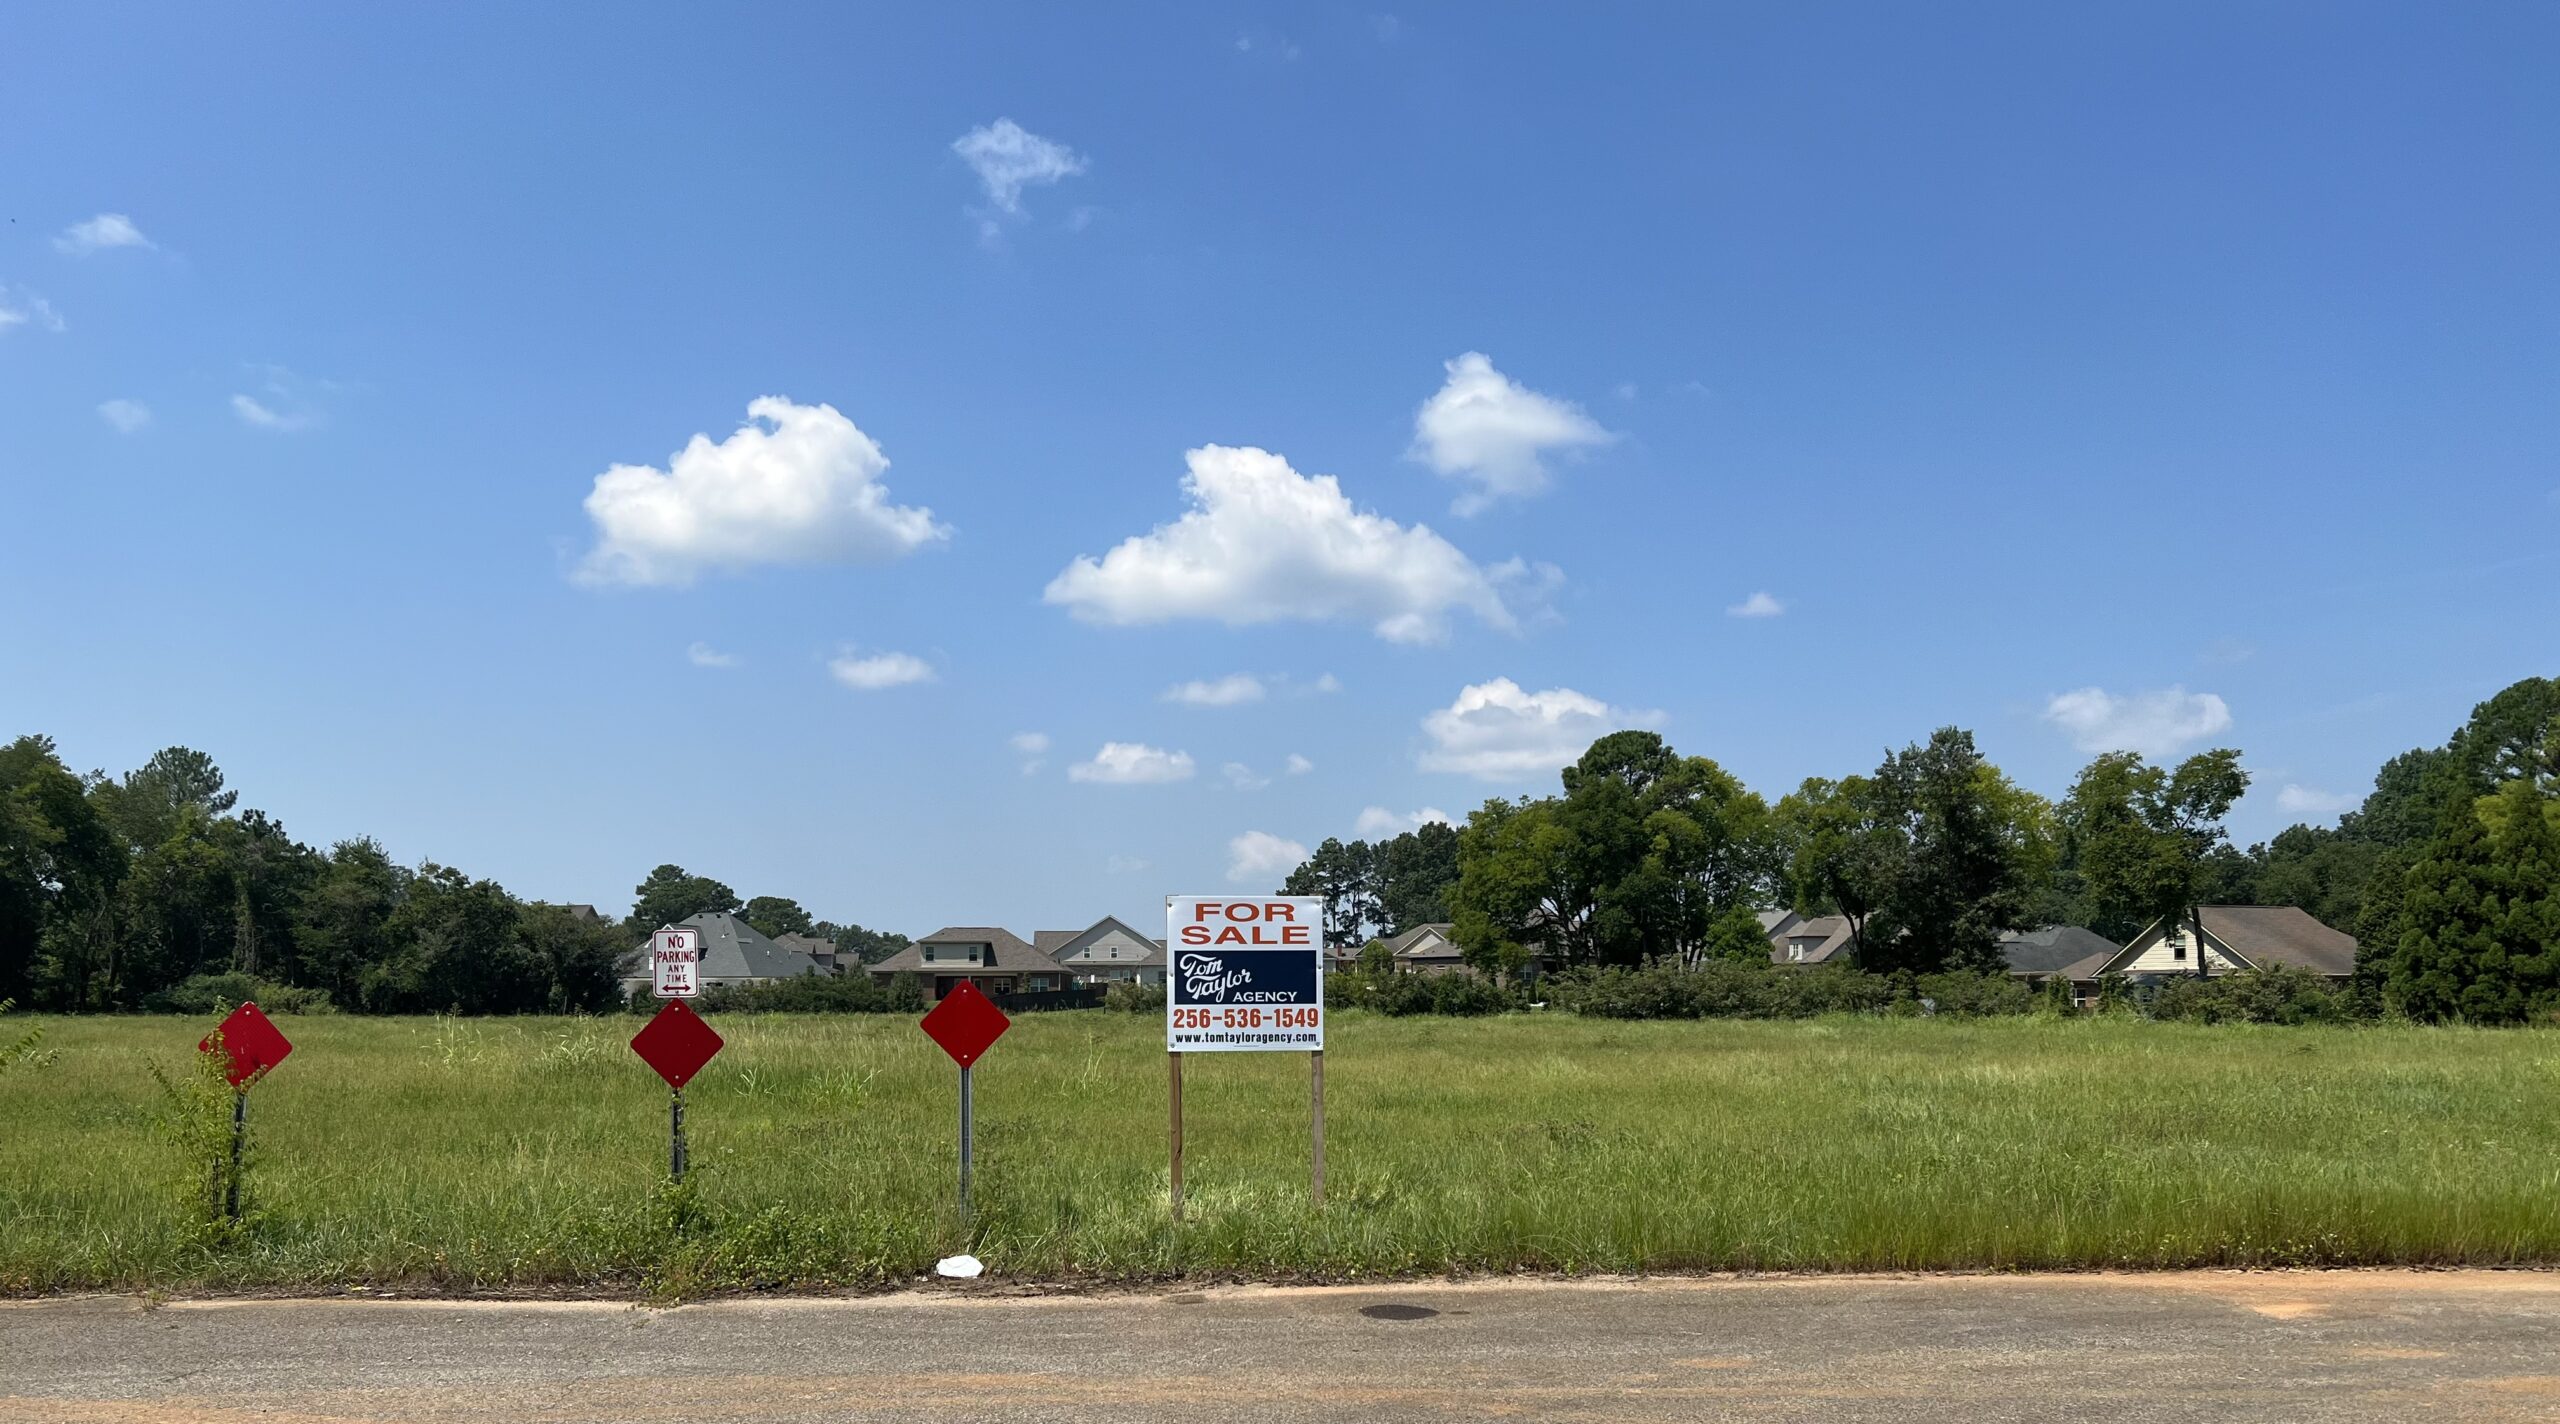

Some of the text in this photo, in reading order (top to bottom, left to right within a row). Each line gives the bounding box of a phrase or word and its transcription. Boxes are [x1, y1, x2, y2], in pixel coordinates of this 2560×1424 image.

[1195, 903, 1295, 922] FOR
[1181, 925, 1310, 945] SALE
[668, 936, 684, 949] NO
[657, 950, 695, 963] PARKING
[668, 965, 685, 973] ANY
[1179, 953, 1223, 977] Tom
[666, 975, 687, 983] TIME
[1186, 969, 1252, 1003] Taylor
[1232, 991, 1298, 1002] AGENCY
[1173, 1008, 1319, 1029] 256-536-1549
[1175, 1032, 1317, 1044] www.tomtayloragency.com
